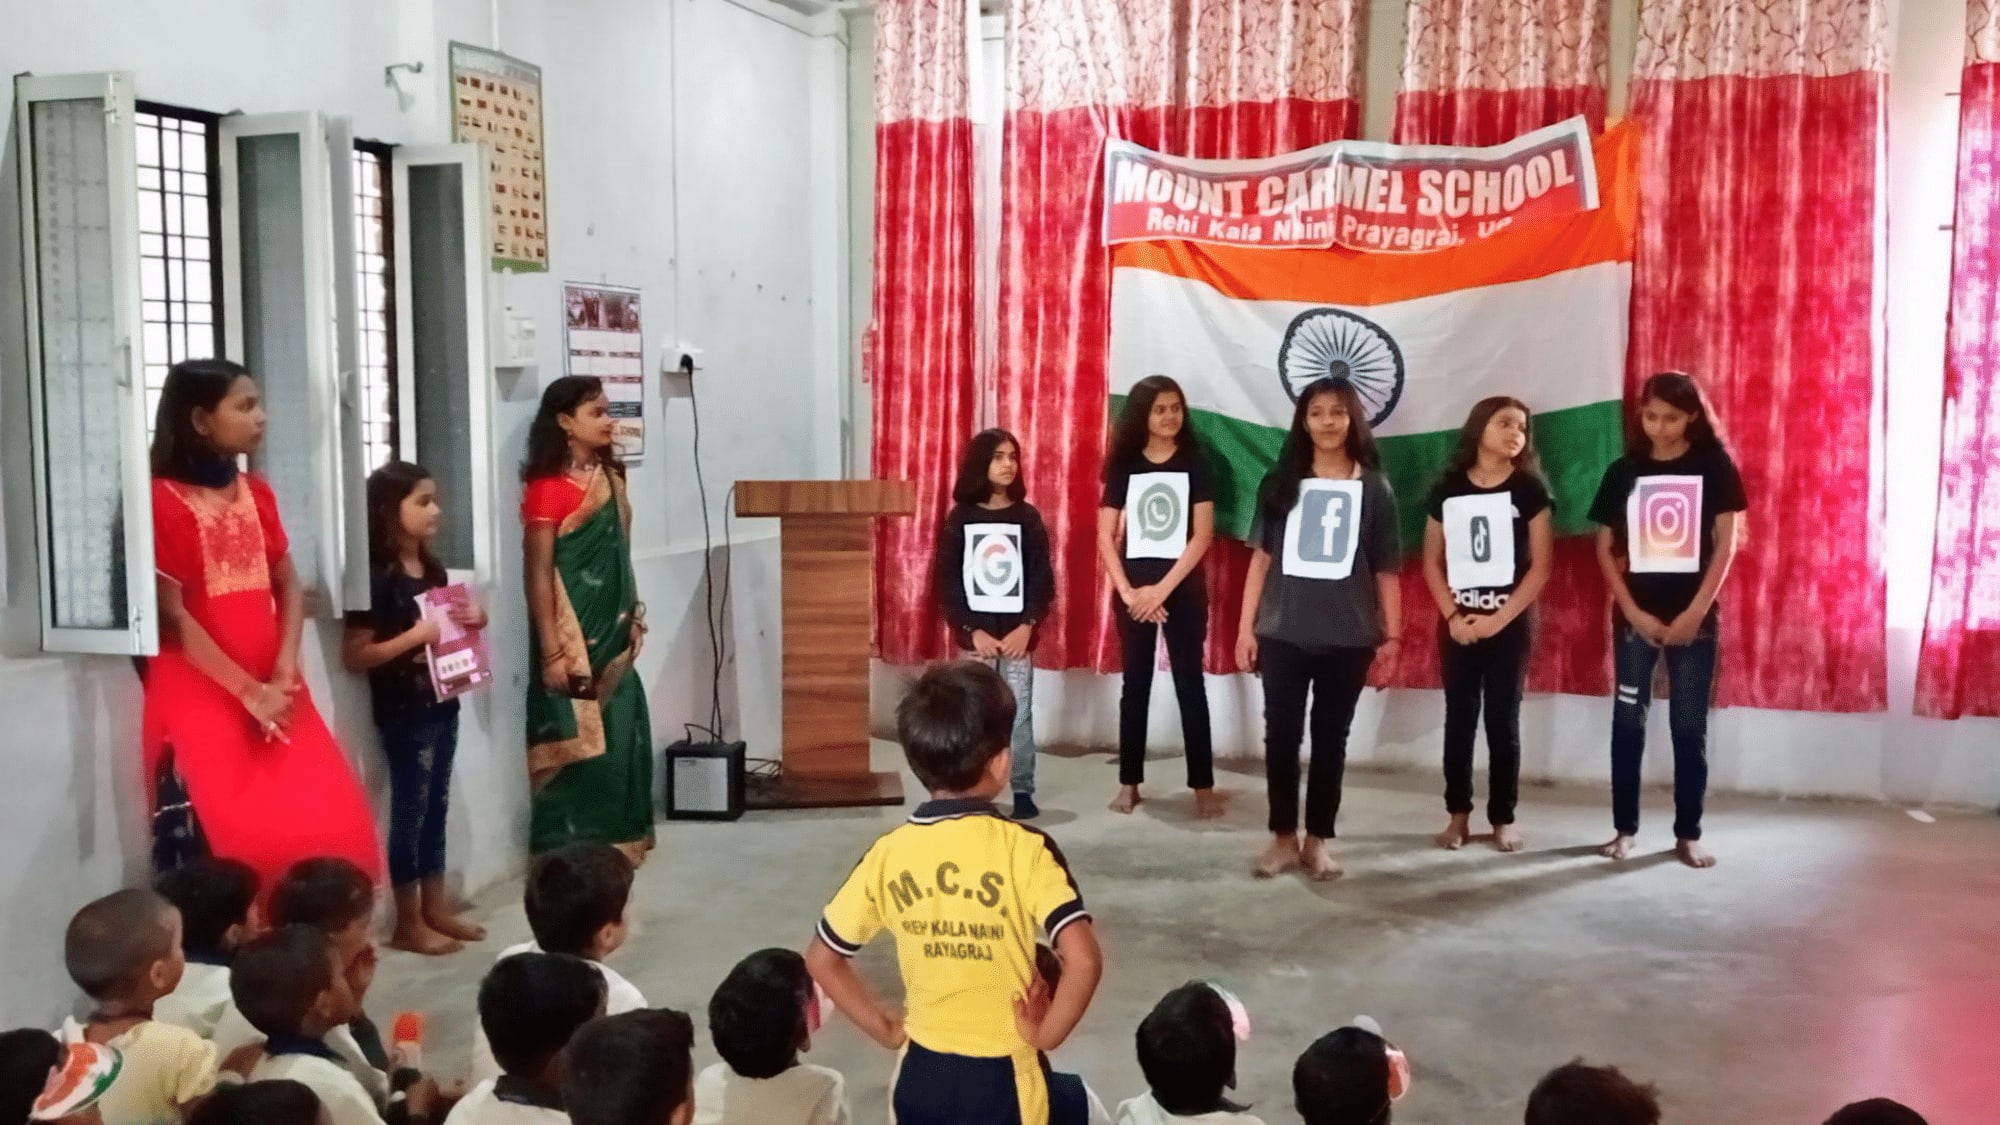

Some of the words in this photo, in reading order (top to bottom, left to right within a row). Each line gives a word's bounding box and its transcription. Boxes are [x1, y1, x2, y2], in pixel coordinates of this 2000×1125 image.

[1114, 159, 1248, 218] MOUNT
[1257, 163, 1407, 217] CARMEL
[1417, 149, 1575, 218] SCHOOL
[1147, 207, 1198, 234] Rehi
[1208, 218, 1262, 241] Kala
[1273, 216, 1335, 241] Naini
[1451, 589, 1509, 609] adida
[887, 861, 1009, 918] M.C.S.
[931, 920, 968, 937] KALA
